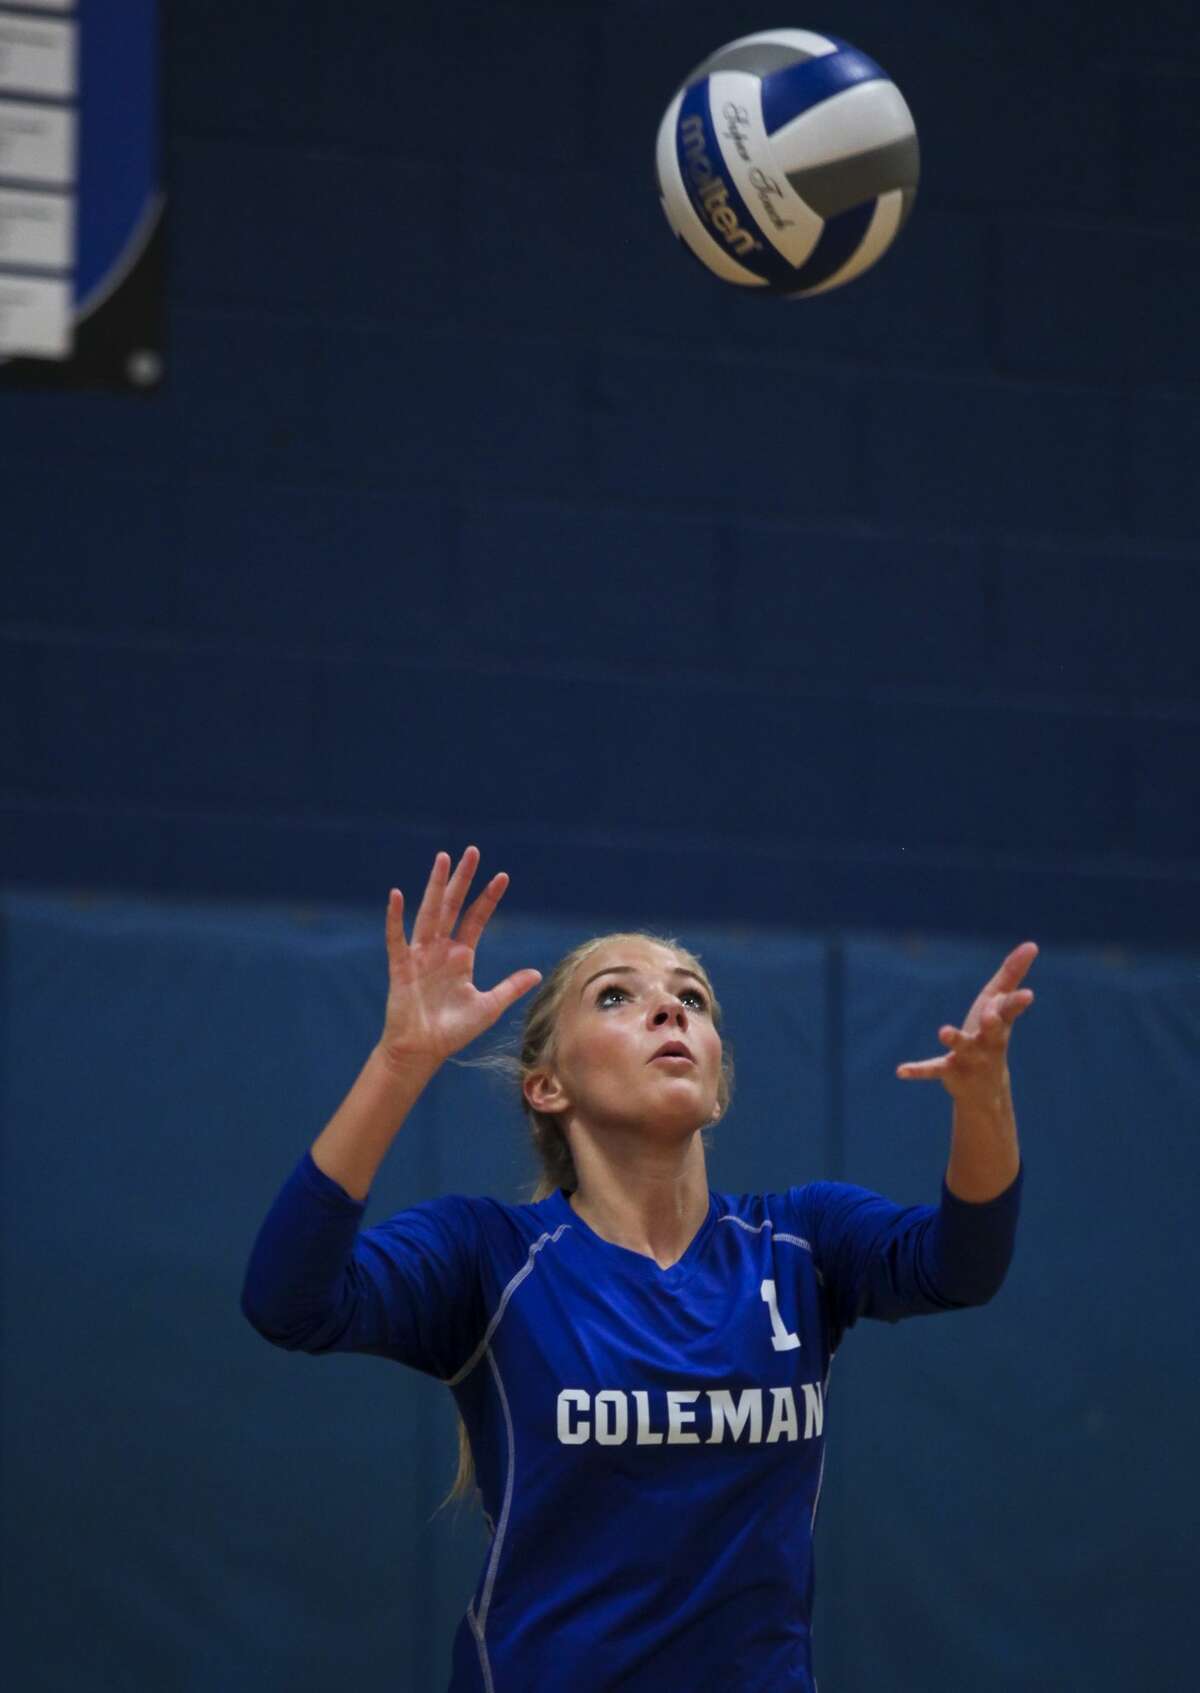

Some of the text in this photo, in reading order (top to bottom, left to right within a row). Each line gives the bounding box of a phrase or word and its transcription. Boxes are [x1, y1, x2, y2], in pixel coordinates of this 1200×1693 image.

[682, 116, 756, 255] molten
[760, 1279, 801, 1351] 1
[556, 1381, 824, 1446] COLEMAN
